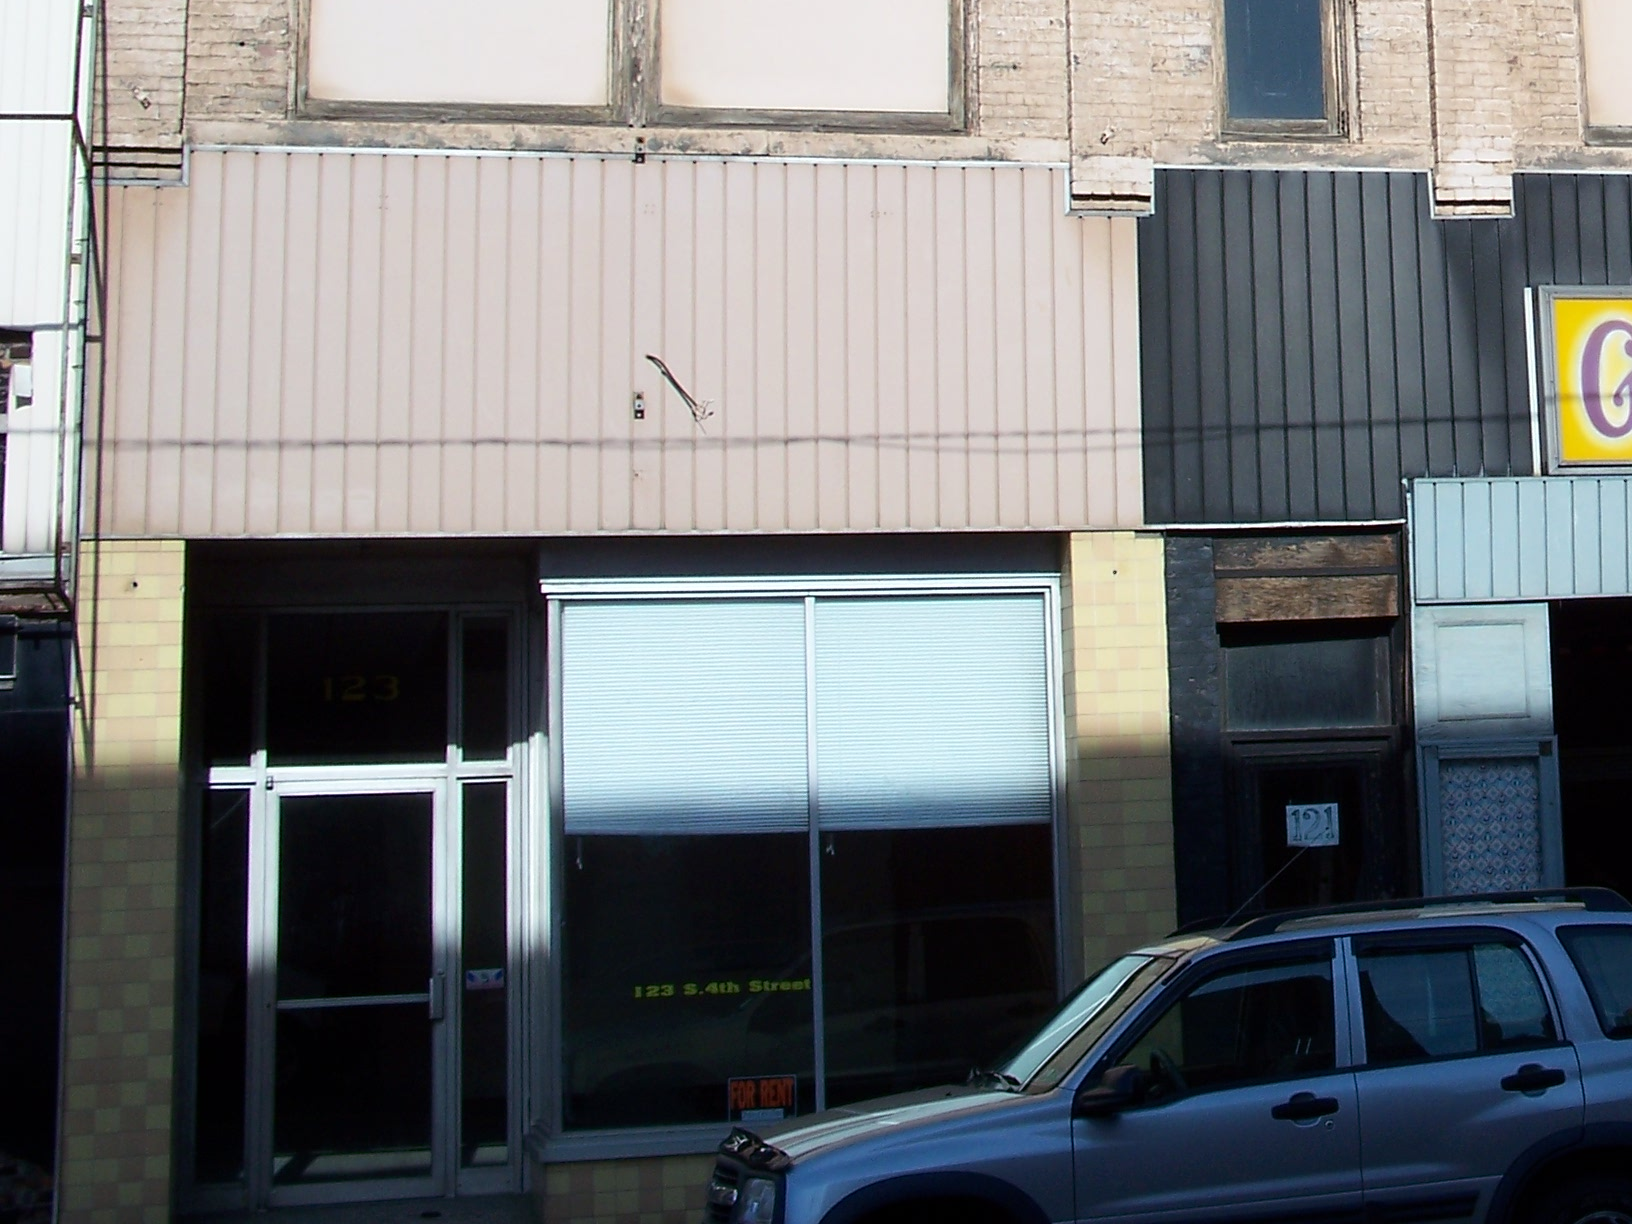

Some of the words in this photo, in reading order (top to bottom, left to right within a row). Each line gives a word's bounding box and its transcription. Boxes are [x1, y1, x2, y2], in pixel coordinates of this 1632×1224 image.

[322, 675, 399, 700] 123
[1290, 805, 1336, 841] 121
[634, 984, 675, 998] 123
[682, 980, 740, 996] S.4th
[748, 978, 812, 993] Street
[731, 1080, 756, 1110] FOR
[759, 1077, 795, 1108] RENT
